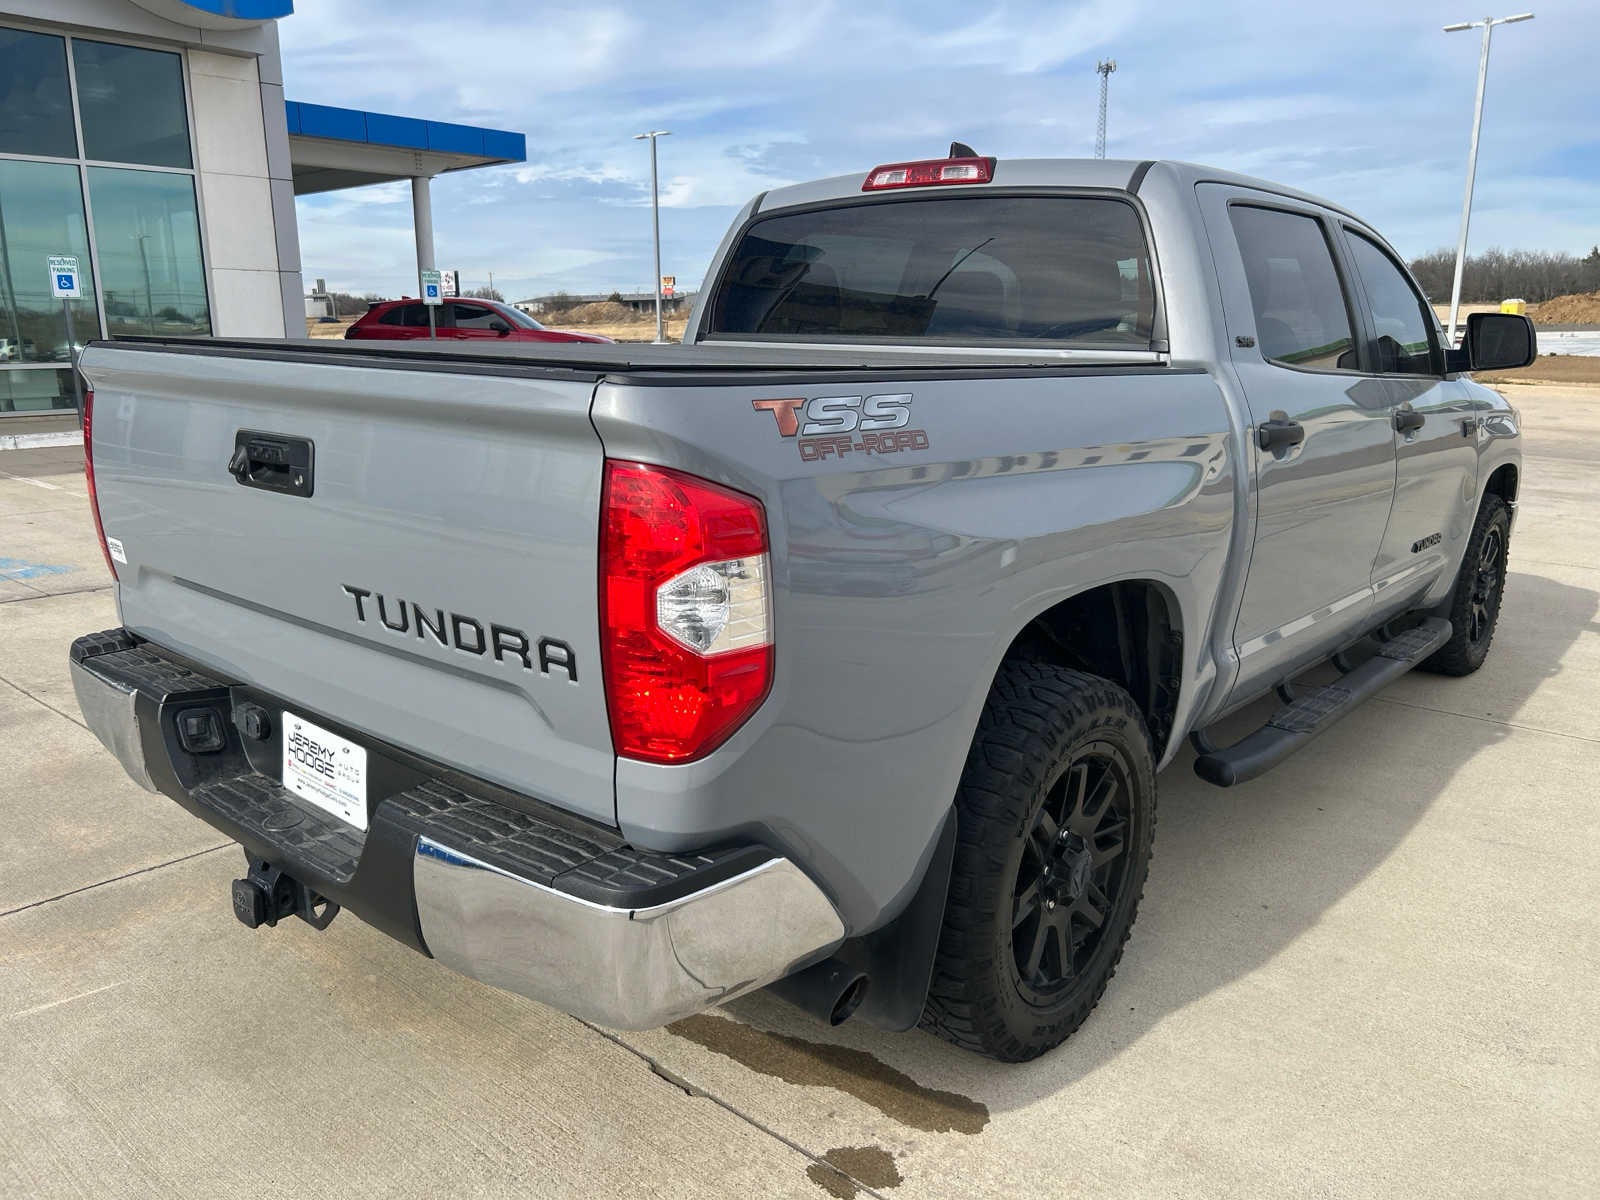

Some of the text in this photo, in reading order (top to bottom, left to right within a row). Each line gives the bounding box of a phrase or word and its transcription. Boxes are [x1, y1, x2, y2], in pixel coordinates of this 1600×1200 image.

[752, 393, 913, 437] TSS
[798, 430, 929, 462] OFF-ROAD
[341, 584, 579, 686] TUNDRA
[288, 731, 336, 762] JEREMY
[288, 742, 335, 780] HODGE
